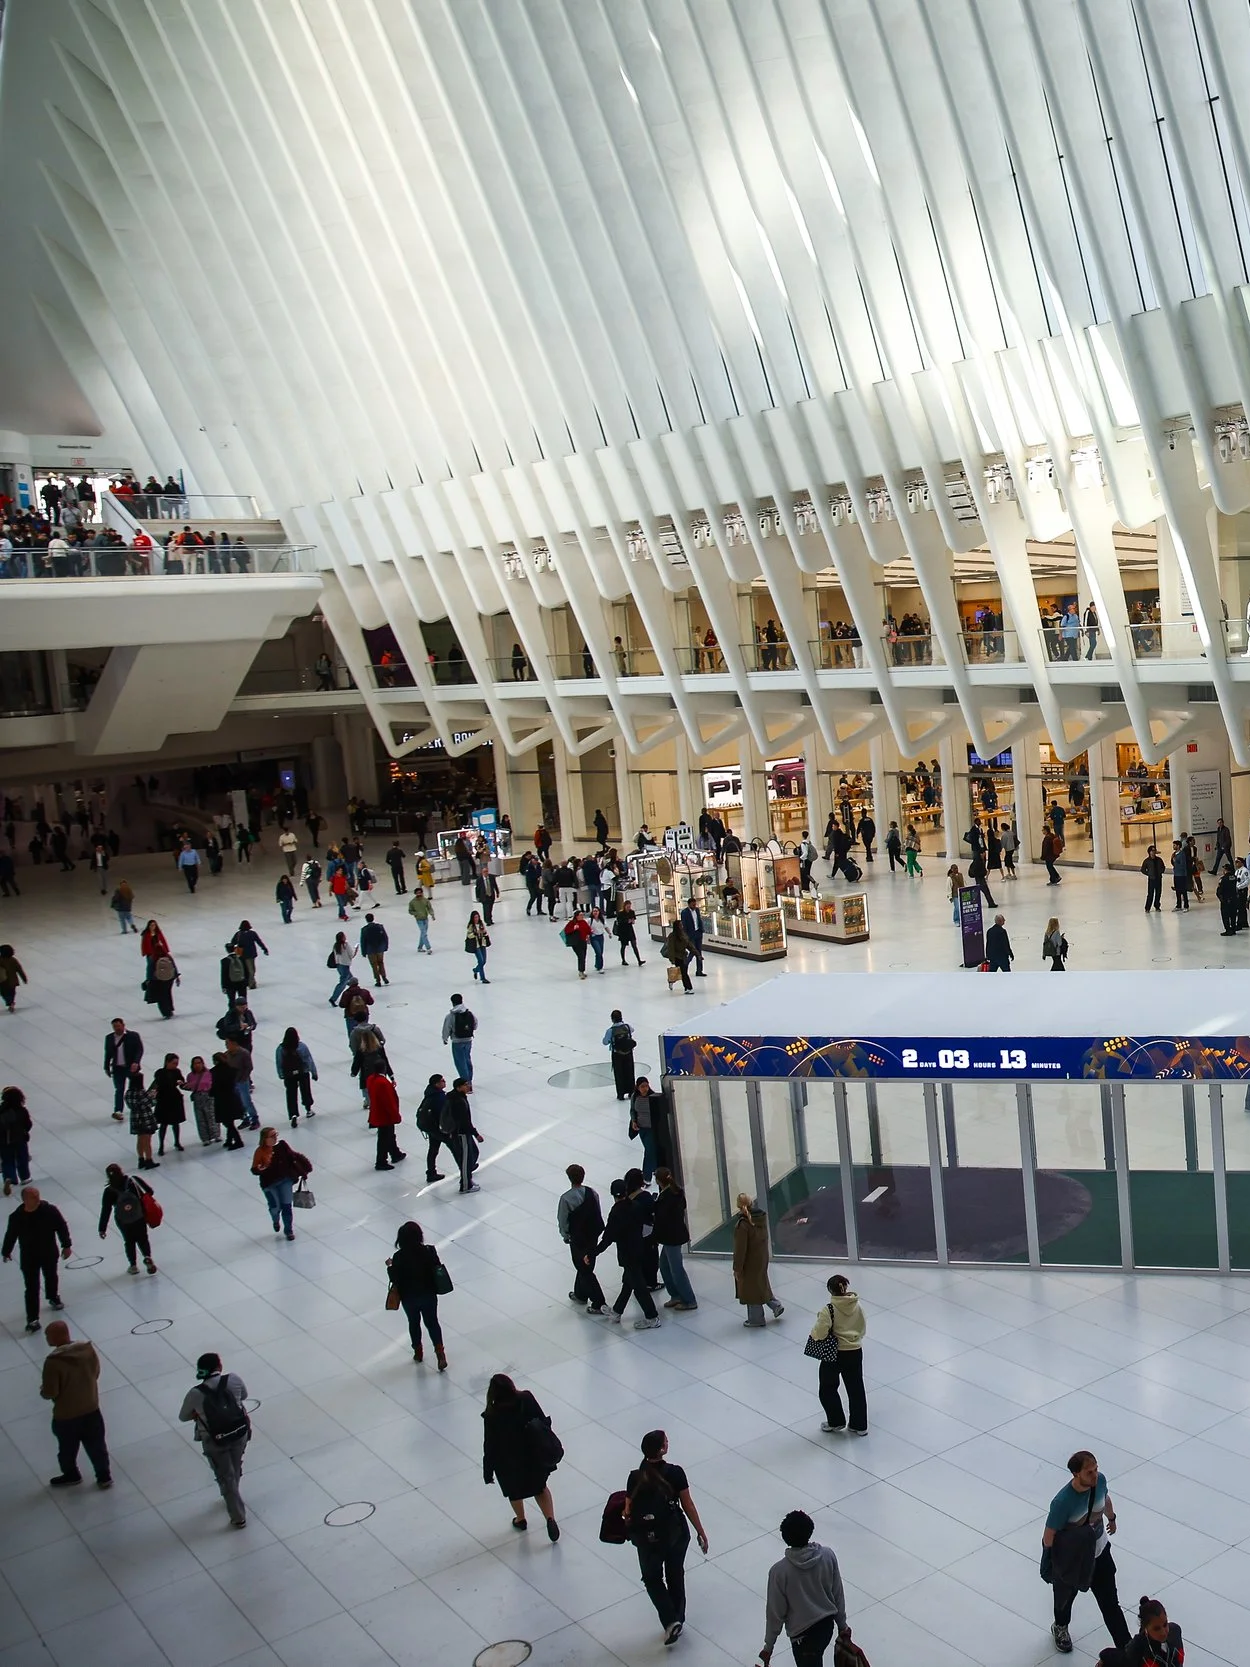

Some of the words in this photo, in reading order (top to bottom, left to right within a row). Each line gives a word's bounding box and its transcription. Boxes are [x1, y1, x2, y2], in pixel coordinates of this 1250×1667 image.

[902, 1049, 918, 1068] 2
[938, 1049, 970, 1069] 03
[1000, 1049, 1027, 1069] 13
